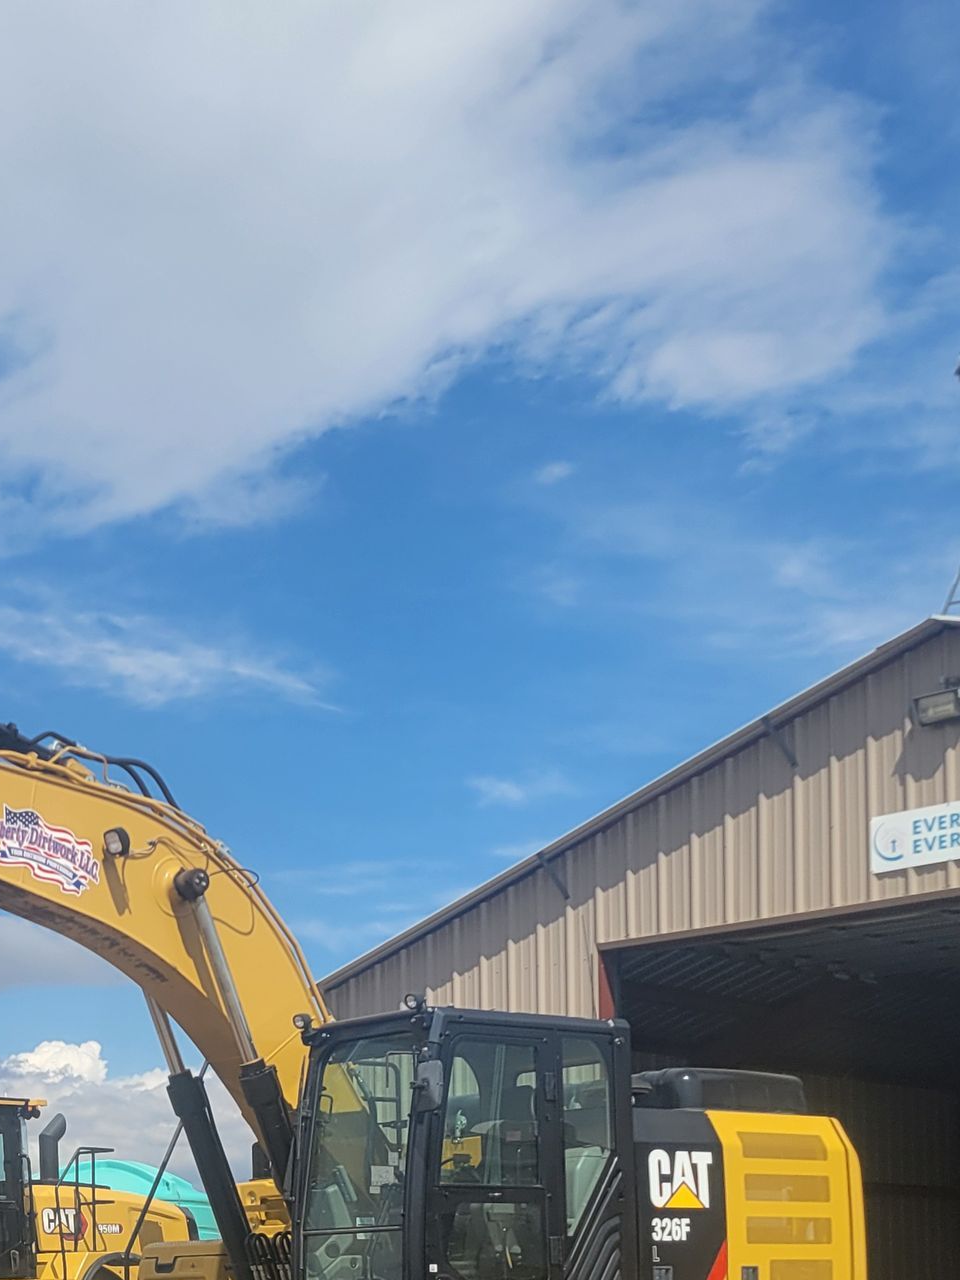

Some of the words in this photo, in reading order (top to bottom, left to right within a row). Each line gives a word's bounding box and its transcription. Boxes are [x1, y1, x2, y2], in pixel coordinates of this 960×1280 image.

[29, 826, 77, 864] Dirtwork
[648, 1149, 713, 1209] CAT
[42, 1208, 76, 1234] CAT
[97, 1224, 120, 1234] 950M
[651, 1218, 691, 1241] 326F
